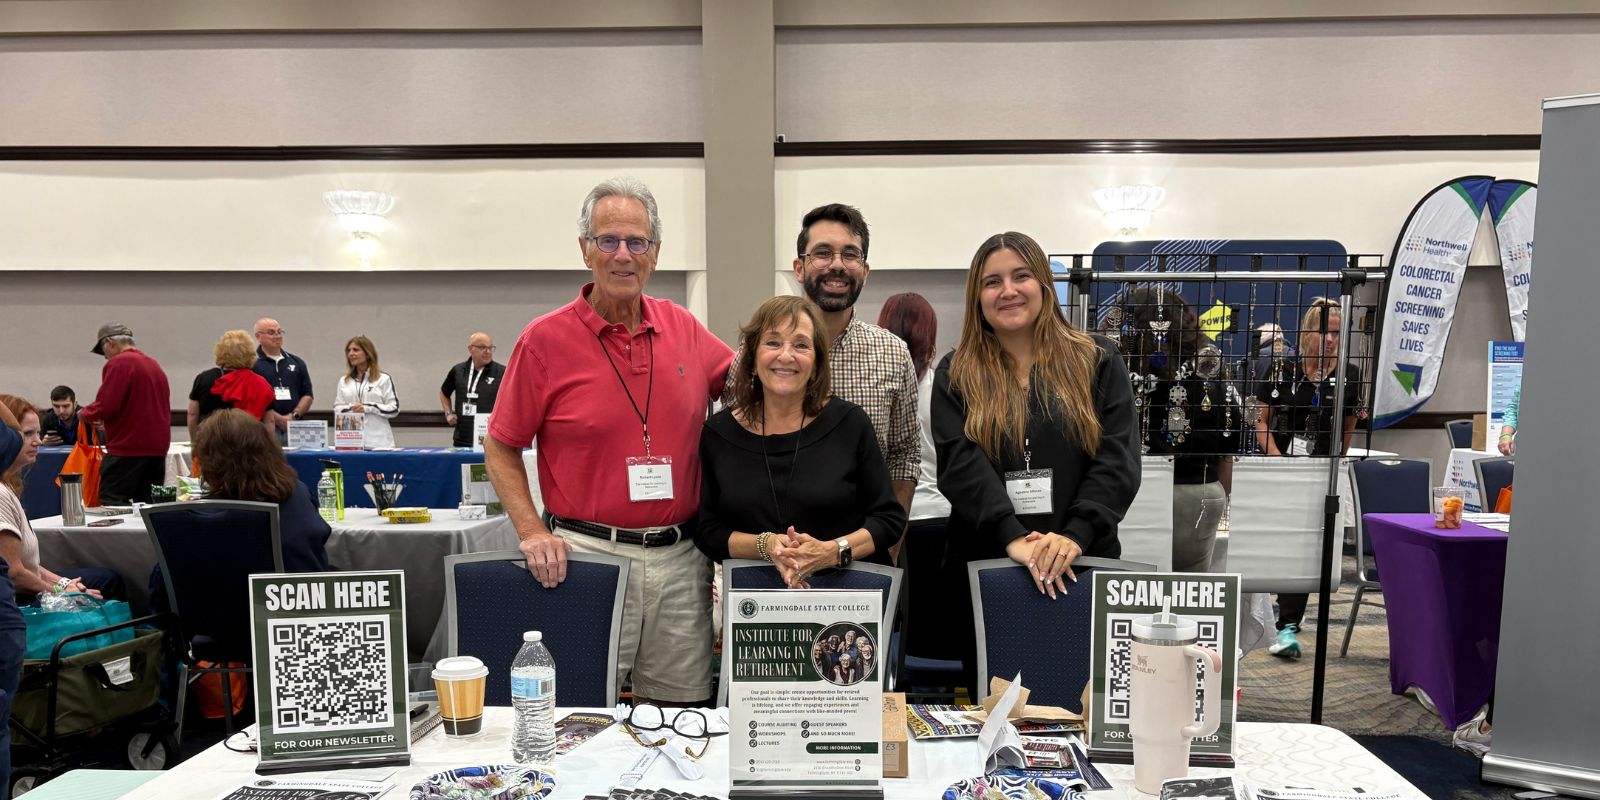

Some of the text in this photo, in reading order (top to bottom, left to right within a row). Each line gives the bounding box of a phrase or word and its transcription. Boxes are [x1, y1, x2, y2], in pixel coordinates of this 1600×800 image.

[1423, 246, 1449, 257] Health
[1425, 237, 1468, 252] Northwell
[1399, 264, 1456, 284] COLORECTAL
[1406, 284, 1442, 300] CANCER
[1394, 301, 1446, 319] SCREENING
[1401, 320, 1430, 335] SAVES
[1399, 338, 1424, 353] LIVES
[1459, 479, 1480, 489] Northwe
[265, 580, 391, 611] SCAN HERE
[1106, 579, 1226, 608] SCAN HERE
[735, 629, 813, 642] INSTITUTE FOR
[738, 646, 805, 659] LEARNING IN
[736, 662, 805, 676] RETIREMENT
[274, 734, 394, 749] FOR OUR NEWSLETTER
[1104, 730, 1125, 739] FOR
